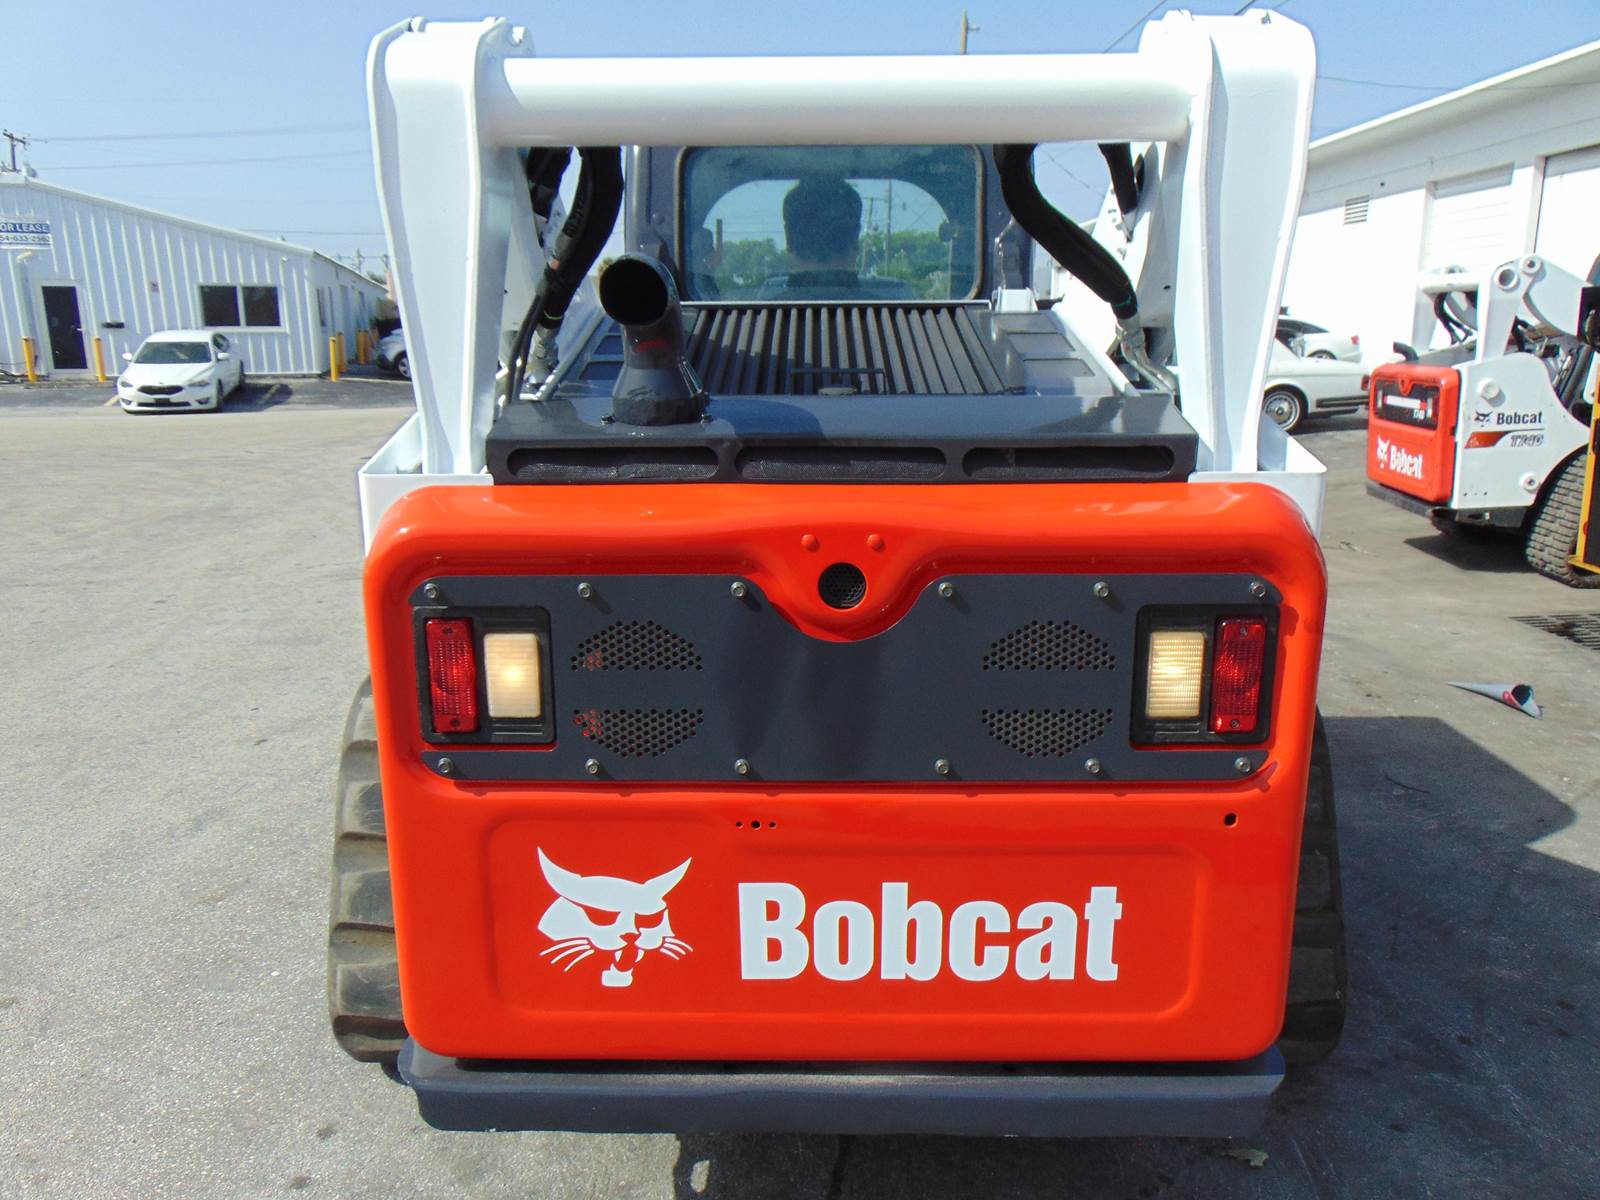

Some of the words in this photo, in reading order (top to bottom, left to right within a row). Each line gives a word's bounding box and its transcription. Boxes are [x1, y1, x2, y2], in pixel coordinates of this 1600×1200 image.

[16, 223, 49, 232] LEASE
[1496, 410, 1543, 425] Bobcat
[1390, 444, 1423, 479] Bobcat
[737, 881, 1123, 982] Bobcat
